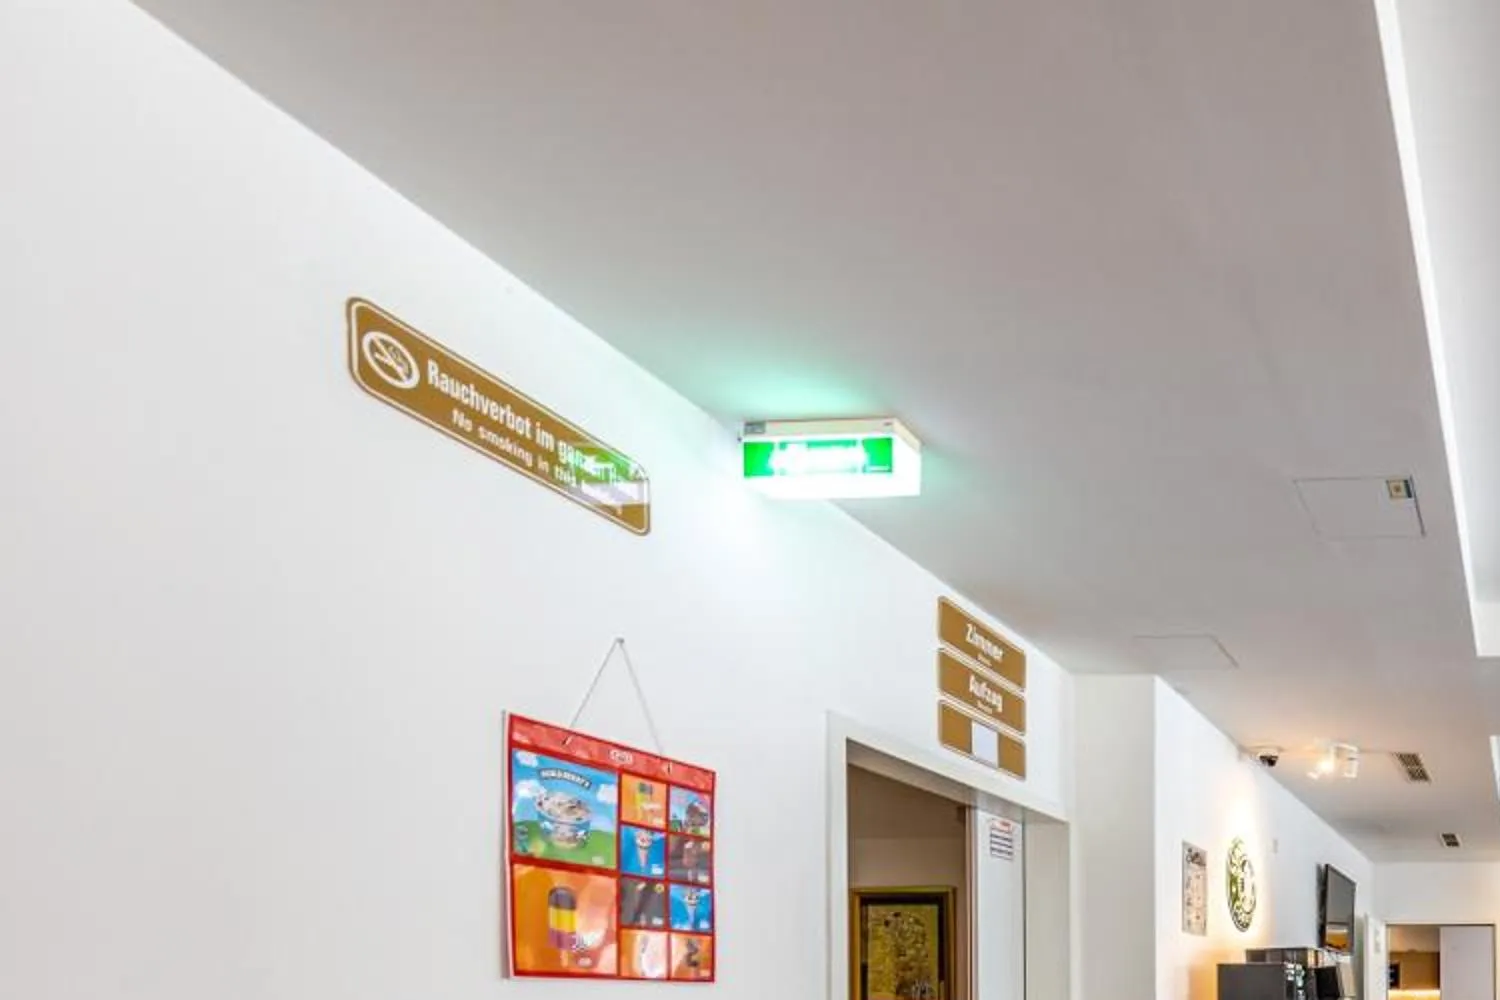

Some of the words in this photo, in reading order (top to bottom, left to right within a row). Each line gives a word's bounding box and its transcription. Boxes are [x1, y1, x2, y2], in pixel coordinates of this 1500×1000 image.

[427, 358, 531, 439] Rauchverbot
[535, 421, 554, 452] im
[452, 408, 472, 432] No
[478, 426, 533, 467] smoking
